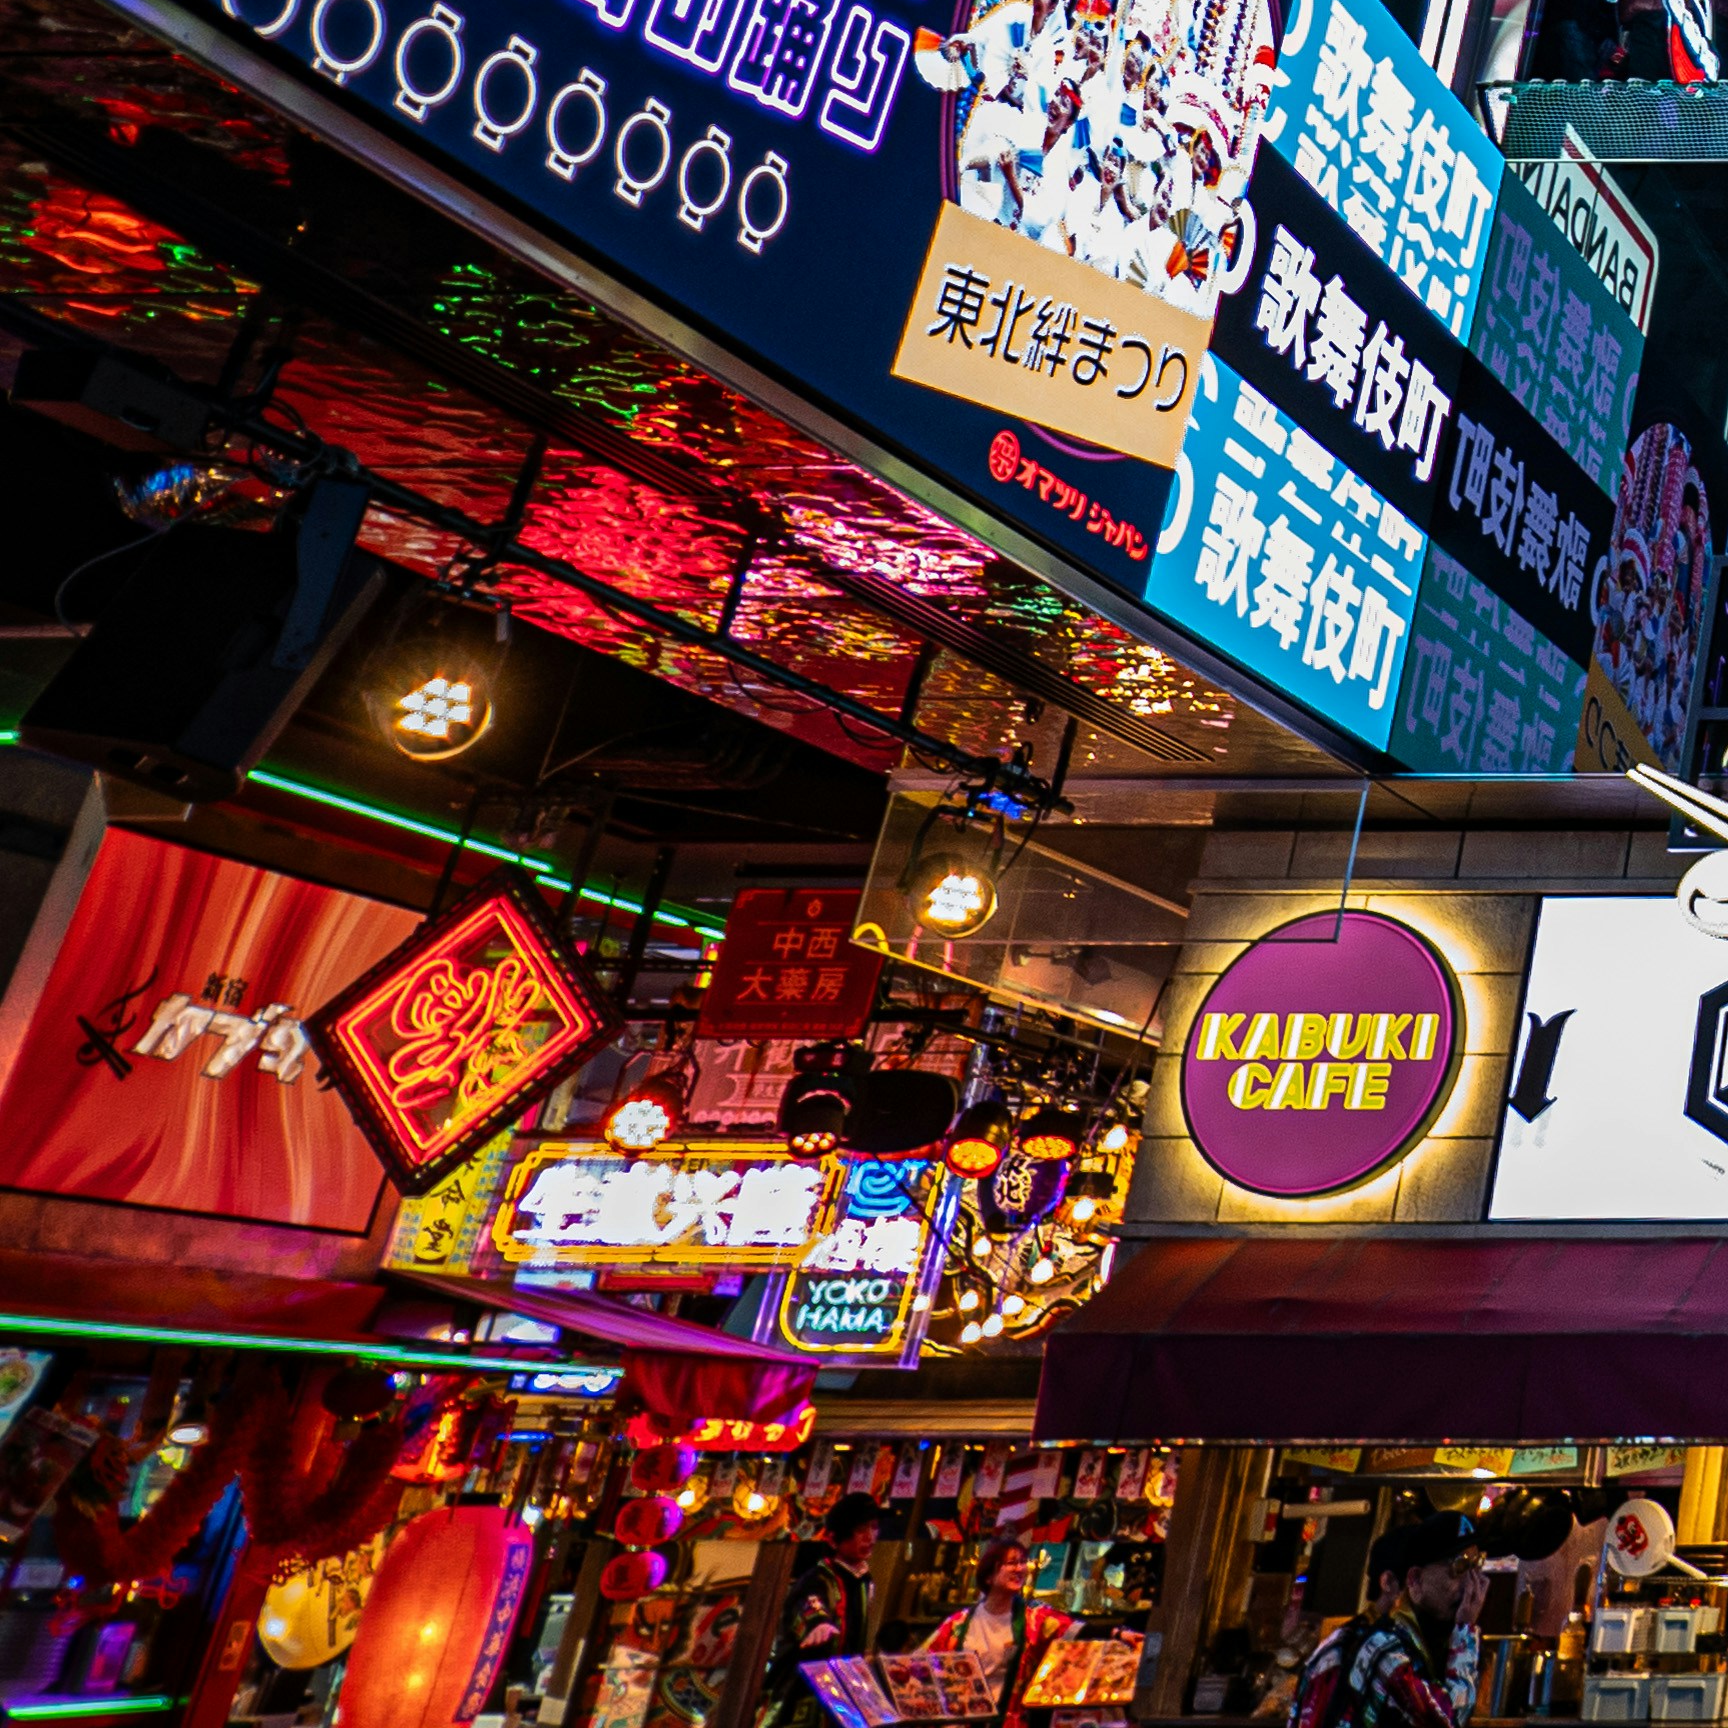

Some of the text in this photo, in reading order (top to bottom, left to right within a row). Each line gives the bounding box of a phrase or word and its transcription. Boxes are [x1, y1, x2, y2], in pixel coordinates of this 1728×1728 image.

[1317, 0, 1497, 269] 歌舞伎町
[923, 264, 1193, 414] 東北絆まつり
[1253, 223, 1454, 484] 歌舞伎町
[1195, 472, 1407, 714] 歌舞伎町
[772, 927, 844, 963] 中西
[1196, 1010, 1441, 1062] KABUKI
[1228, 1061, 1394, 1112] CAFE
[805, 1278, 891, 1306] YOKO
[797, 1305, 889, 1333] HAMA
